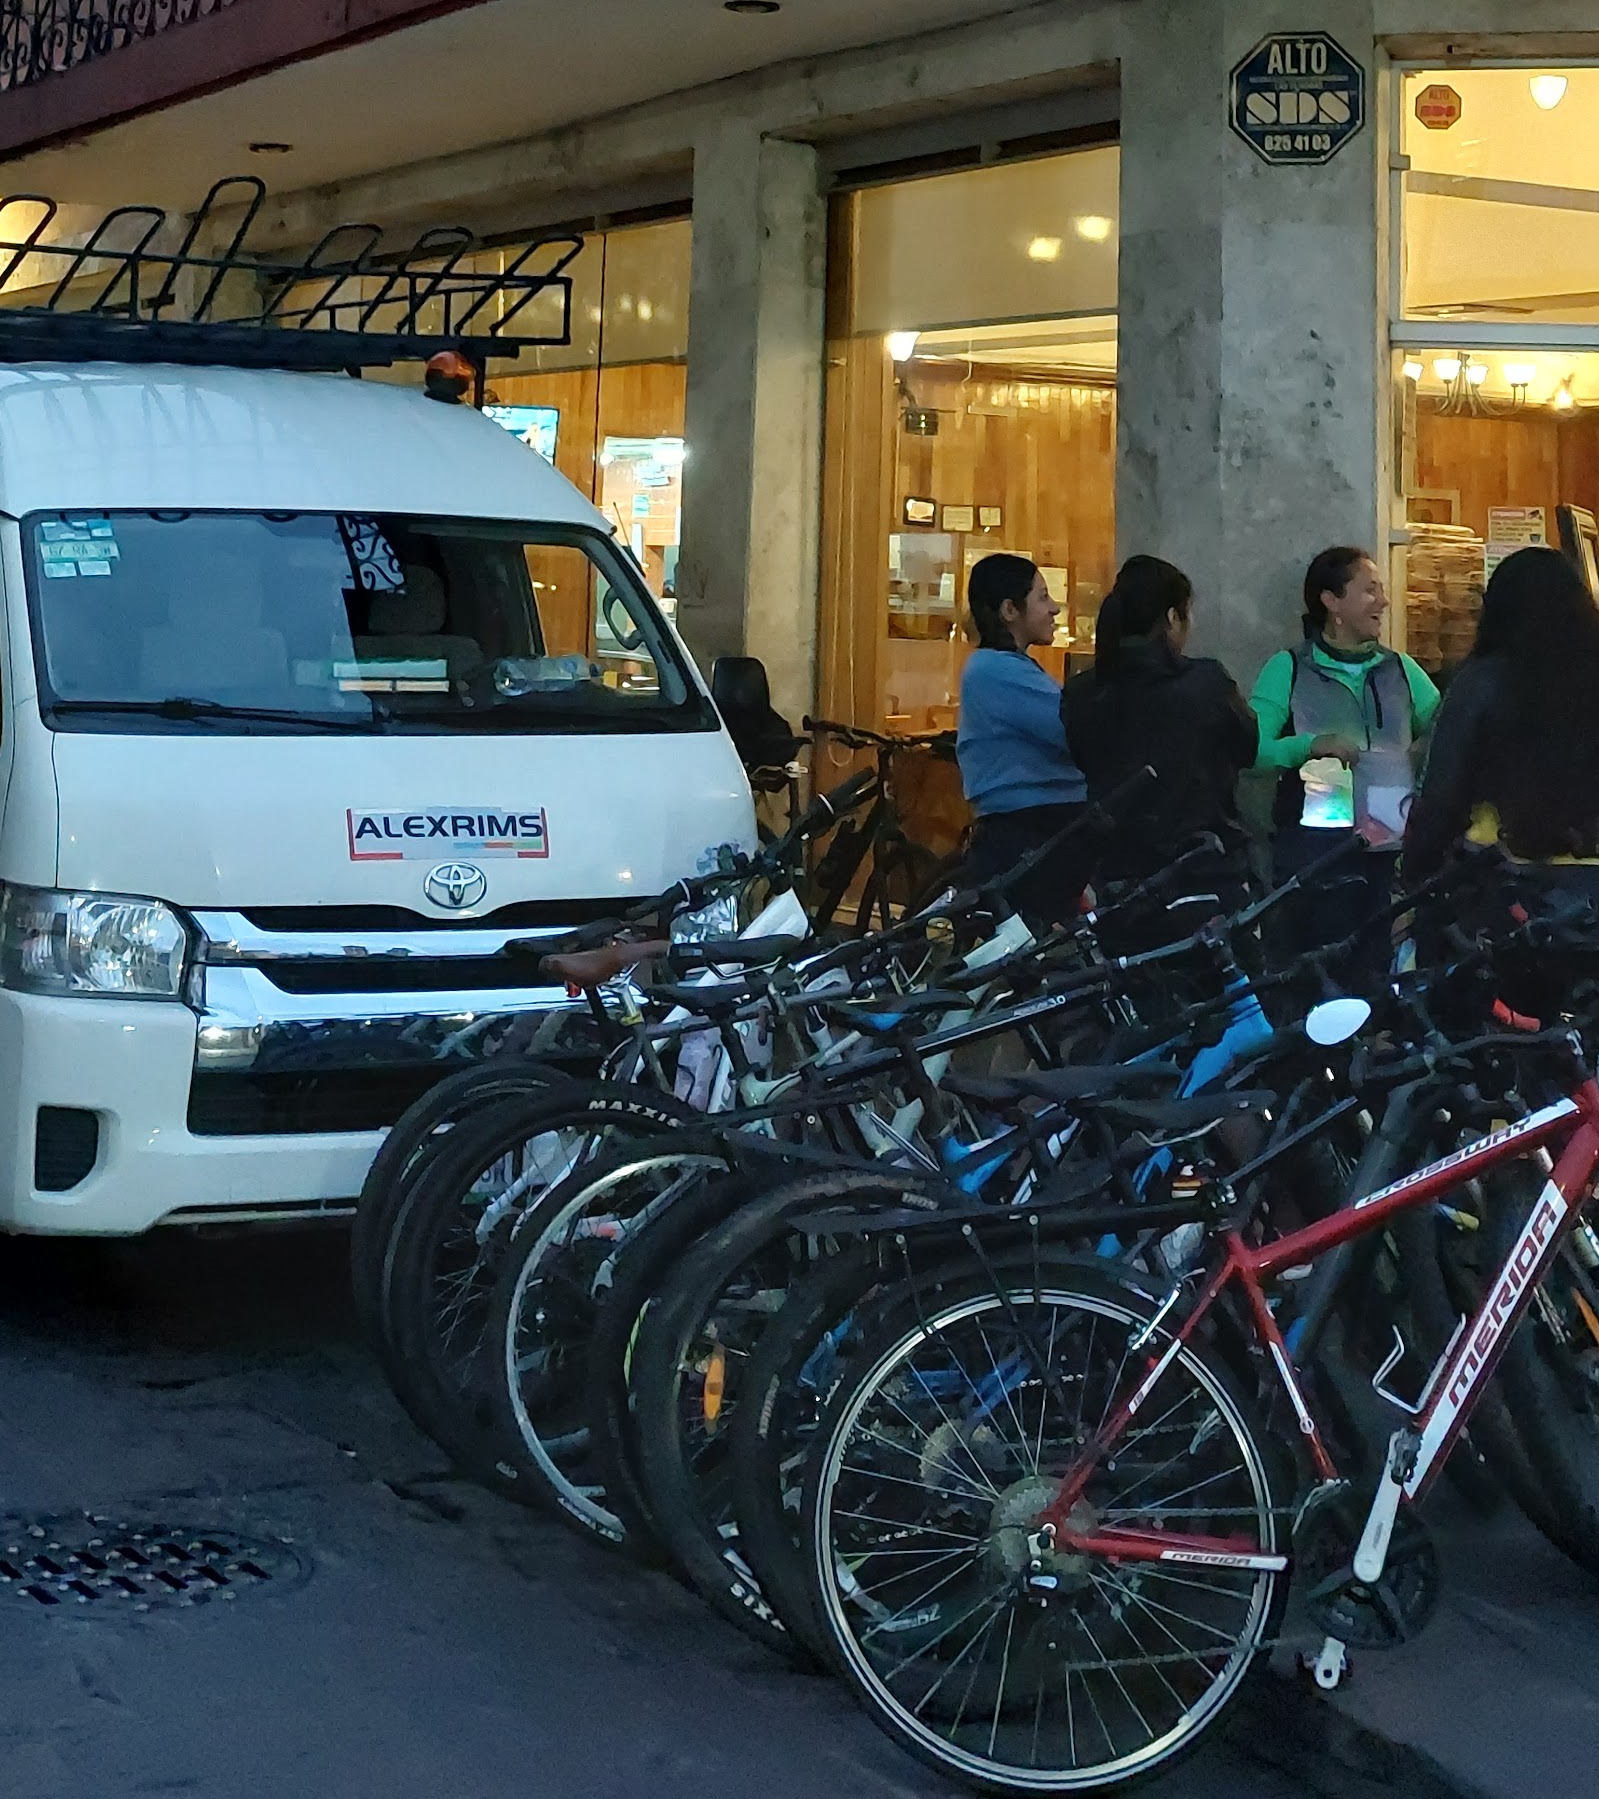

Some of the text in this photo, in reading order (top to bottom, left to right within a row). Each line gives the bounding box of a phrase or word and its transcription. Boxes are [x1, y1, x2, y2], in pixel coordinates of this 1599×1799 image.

[1267, 40, 1327, 75] ALTO
[1246, 91, 1351, 125] SDS
[1294, 135, 1310, 152] 41
[355, 814, 543, 839] ALEXRIMS
[1446, 1201, 1558, 1408] MERIDA
[1171, 1552, 1251, 1566] MERIDA
